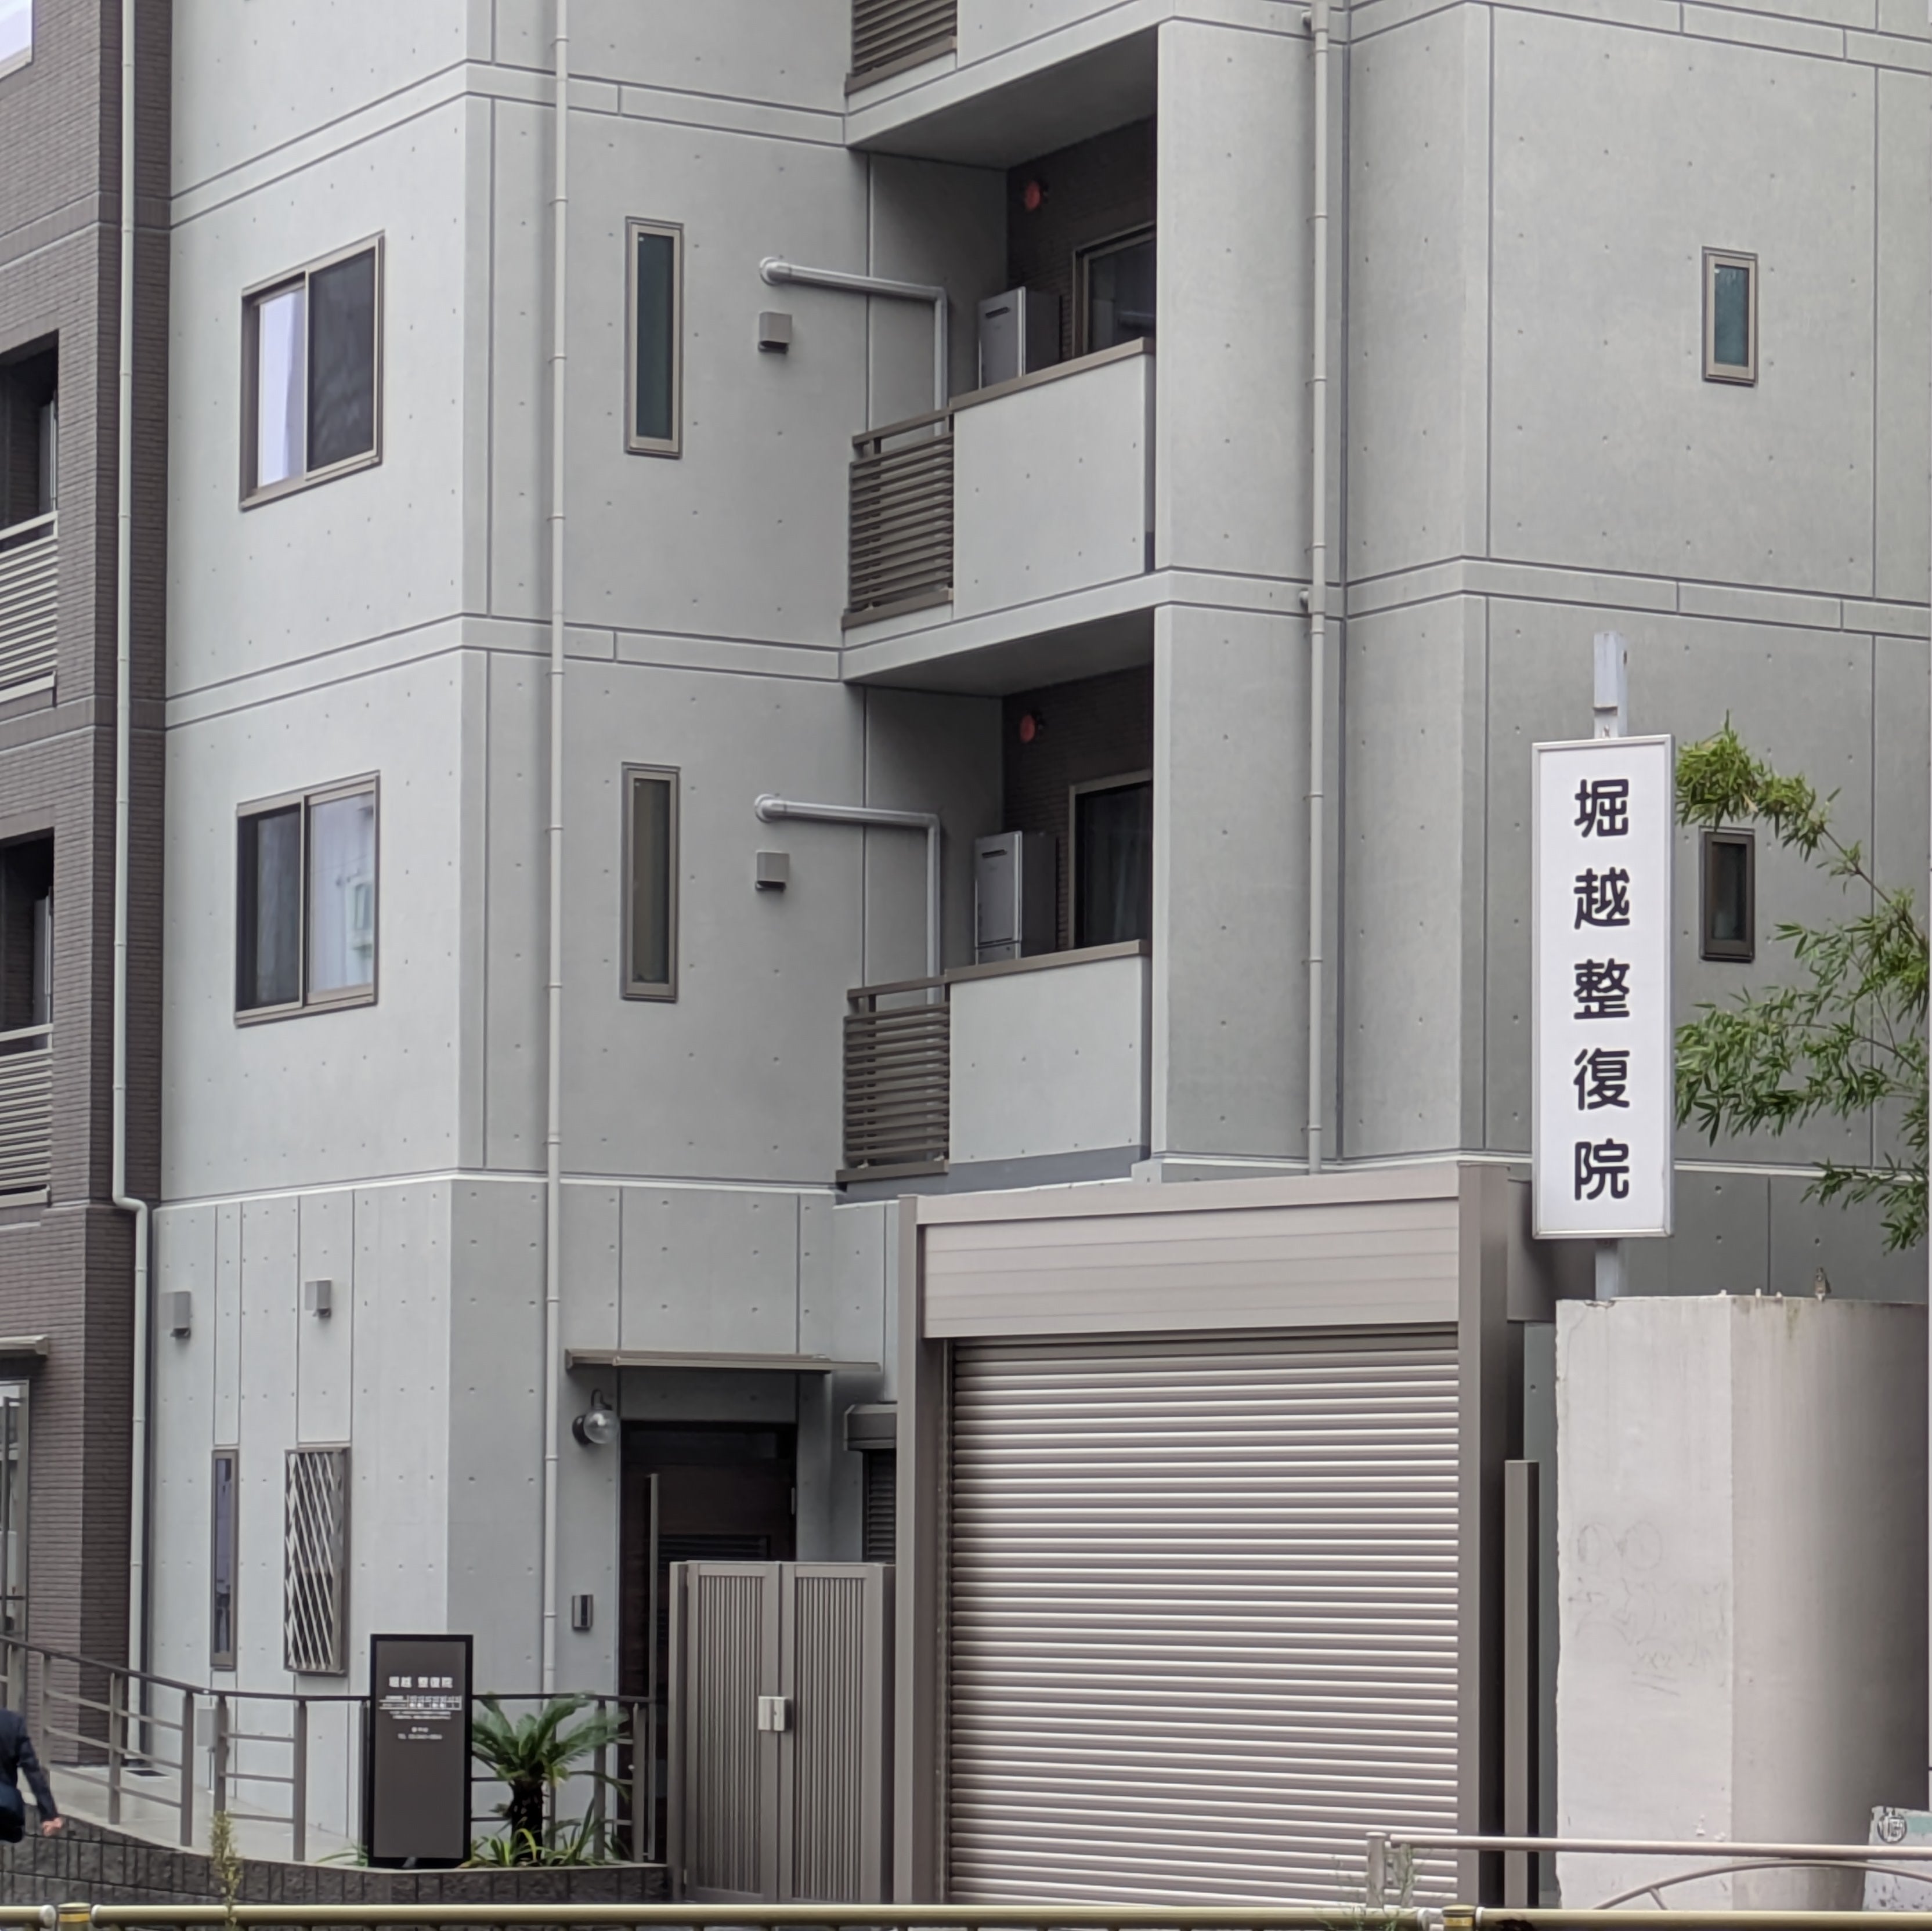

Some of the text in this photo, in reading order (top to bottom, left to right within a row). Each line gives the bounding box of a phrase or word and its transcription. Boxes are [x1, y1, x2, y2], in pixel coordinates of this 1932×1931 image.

[1573, 778, 1630, 1200] 堀越整復院
